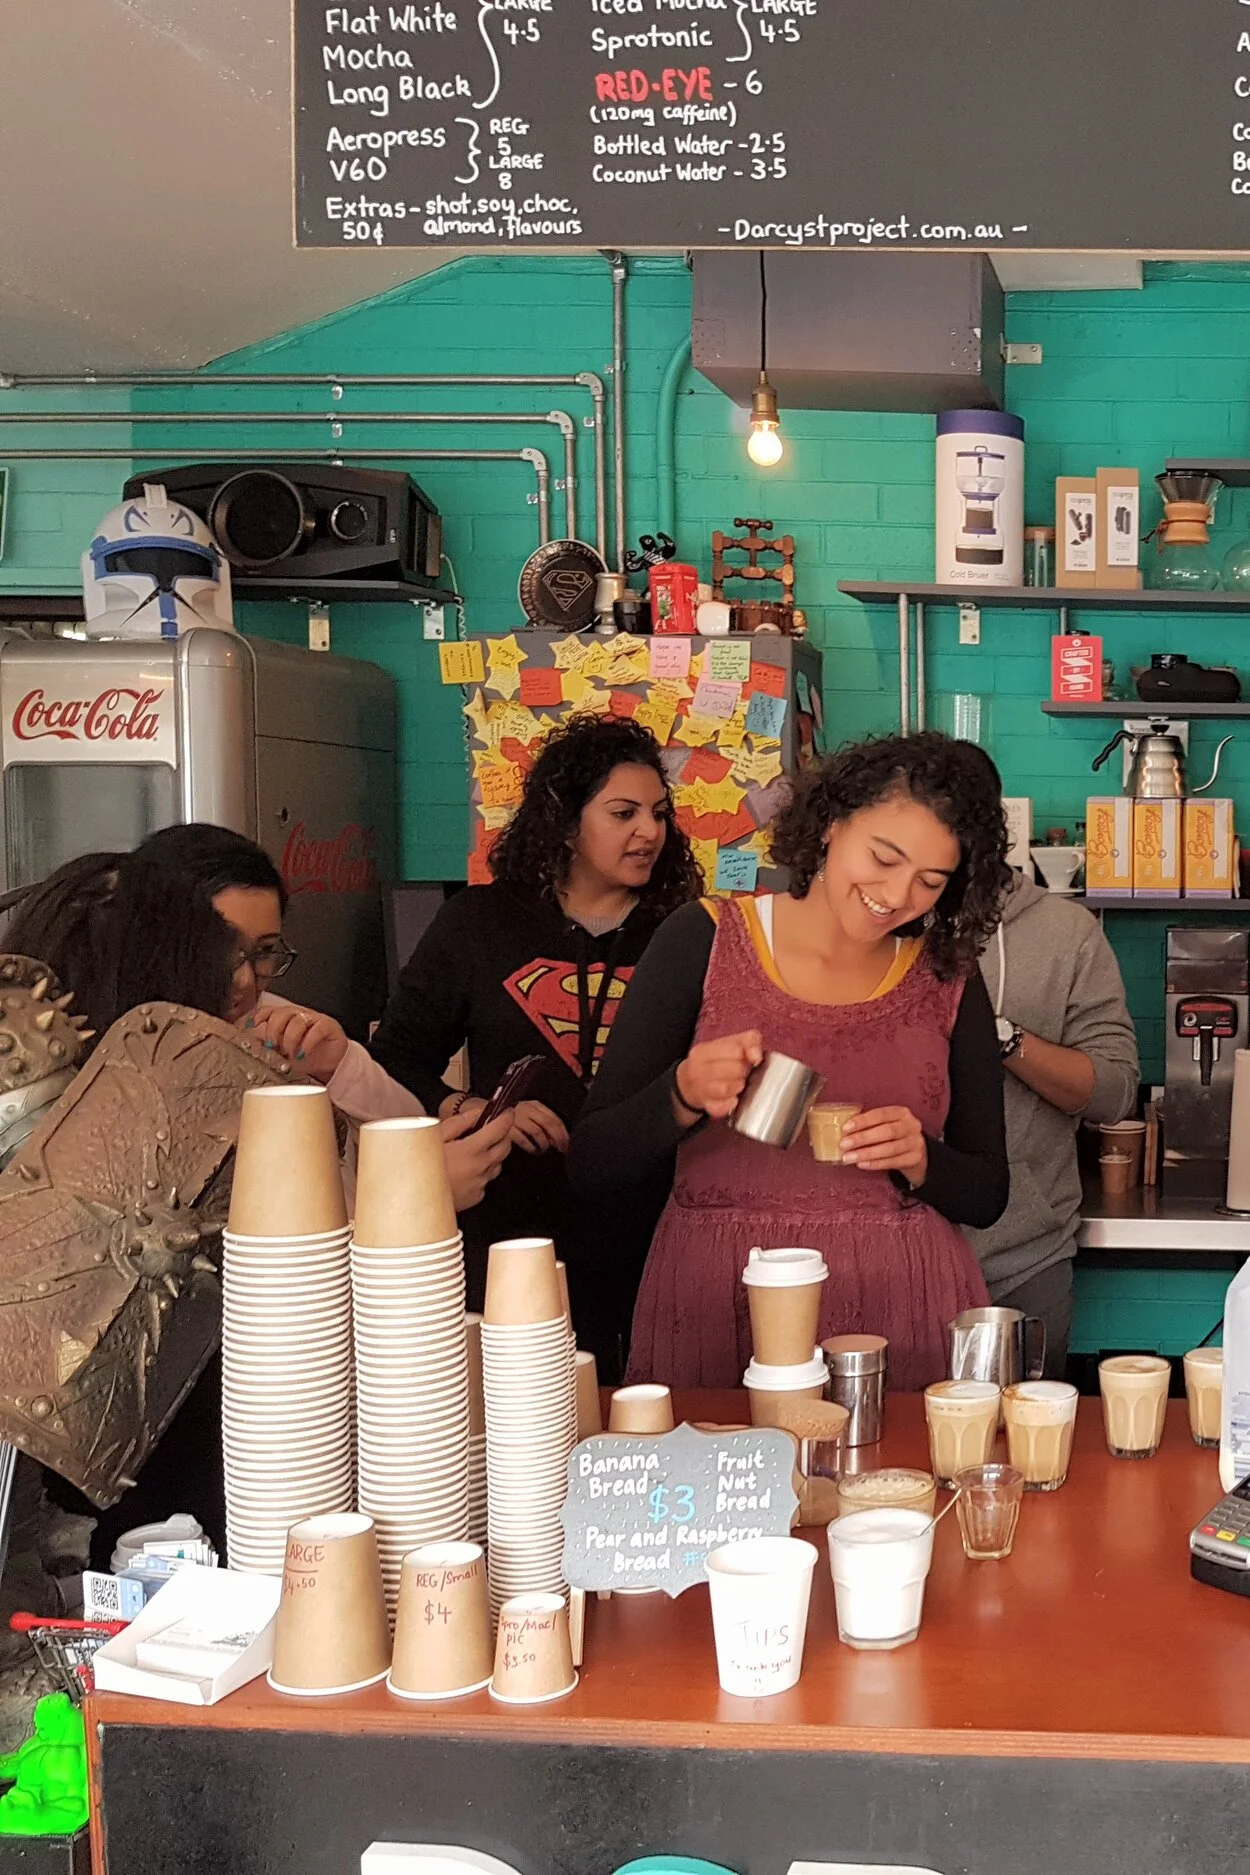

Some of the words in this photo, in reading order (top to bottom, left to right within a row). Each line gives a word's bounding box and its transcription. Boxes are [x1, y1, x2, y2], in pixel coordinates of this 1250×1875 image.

[326, 8, 380, 34] Flat
[390, 5, 457, 32] White
[592, 22, 713, 57] Sprotonic
[323, 45, 413, 71] Mocha
[328, 81, 389, 116] Long
[400, 75, 471, 100] Black
[596, 67, 713, 101] RED-EYE
[490, 118, 529, 135] REG
[590, 105, 654, 125] (120mg
[664, 102, 737, 127] caffeine)
[326, 126, 446, 158] Aeropress
[594, 135, 668, 156] Bottled
[675, 136, 733, 156] Water
[330, 159, 387, 182] V60
[489, 153, 544, 170] LARGE
[593, 163, 671, 184] Coconut
[676, 162, 726, 182] Water
[507, 215, 582, 239] flavours
[12, 688, 164, 741] Coca-Cola
[579, 1452, 659, 1476] Banana
[717, 1449, 765, 1471] Fruit
[589, 1472, 648, 1499] Bread
[718, 1474, 757, 1491] Nut
[648, 1484, 696, 1524] $3
[716, 1489, 771, 1513] Bread
[586, 1526, 623, 1550] Pear
[630, 1526, 668, 1546] and
[614, 1549, 671, 1573] Bread
[424, 1600, 452, 1626] $4
